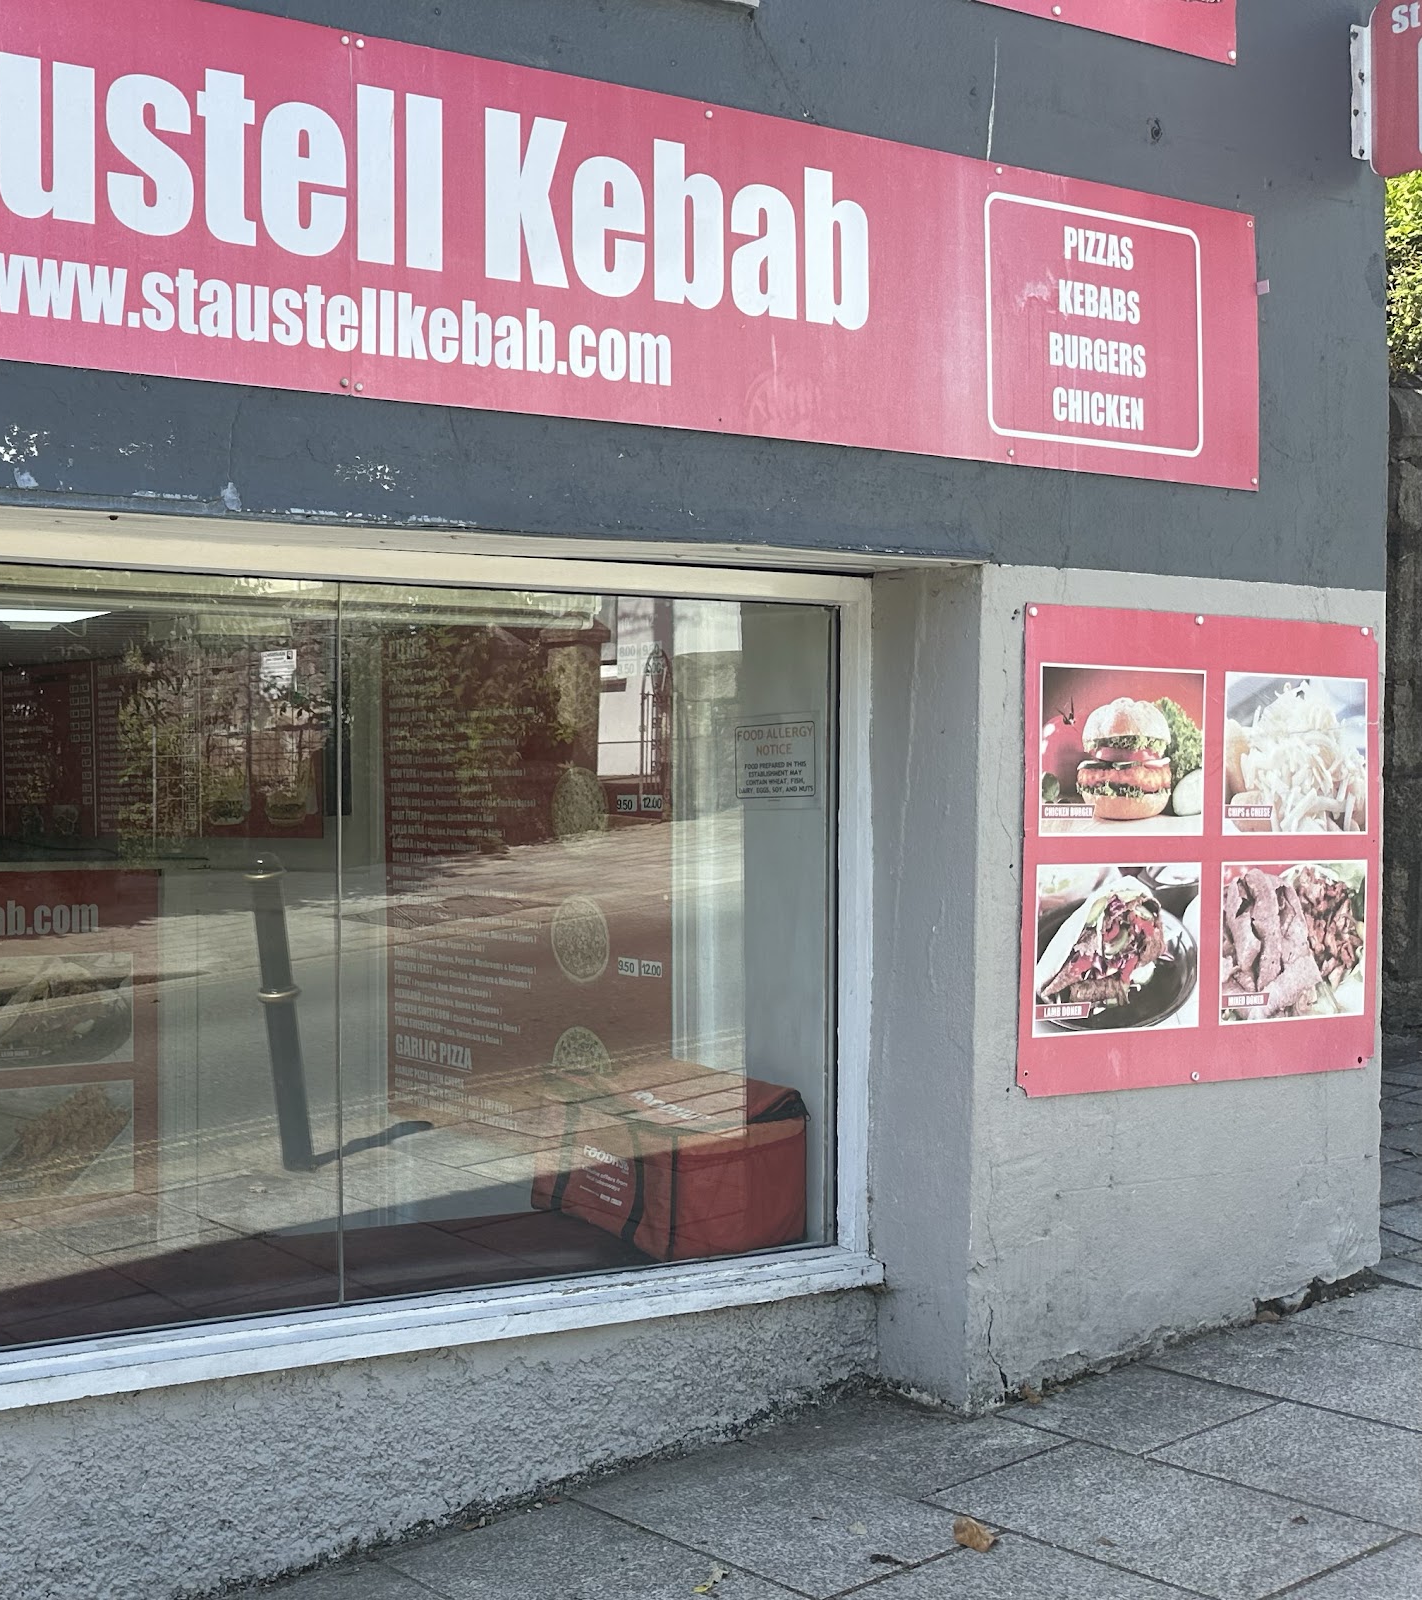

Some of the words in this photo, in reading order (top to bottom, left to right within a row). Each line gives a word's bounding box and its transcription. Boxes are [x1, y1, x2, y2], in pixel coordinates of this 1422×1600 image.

[484, 107, 870, 331] Kebab
[1063, 226, 1135, 272] PIZZAS
[1058, 279, 1141, 327] KEBABS
[1048, 334, 1147, 380] BURGERS
[1052, 386, 1145, 433] CHICKEN
[737, 730, 764, 741] FOOD
[766, 726, 814, 739] ALLERGY
[756, 743, 793, 756] NOTICE
[748, 769, 788, 778] ESTABLISHMENT
[616, 798, 633, 811] 9.50
[642, 798, 662, 809] 12.00
[1044, 806, 1070, 817] CHICKEN
[1070, 806, 1093, 817] BURGER
[1228, 807, 1245, 817] CHIPS
[1250, 807, 1271, 817] CHEESE
[618, 959, 635, 974] 9.50
[642, 962, 661, 977] 12.00
[1246, 994, 1264, 1005] DONER
[1043, 1007, 1061, 1018] LAMB
[1061, 1005, 1082, 1017] DONER
[395, 1033, 437, 1062] GARLIC
[439, 1042, 473, 1070] PIZZA
